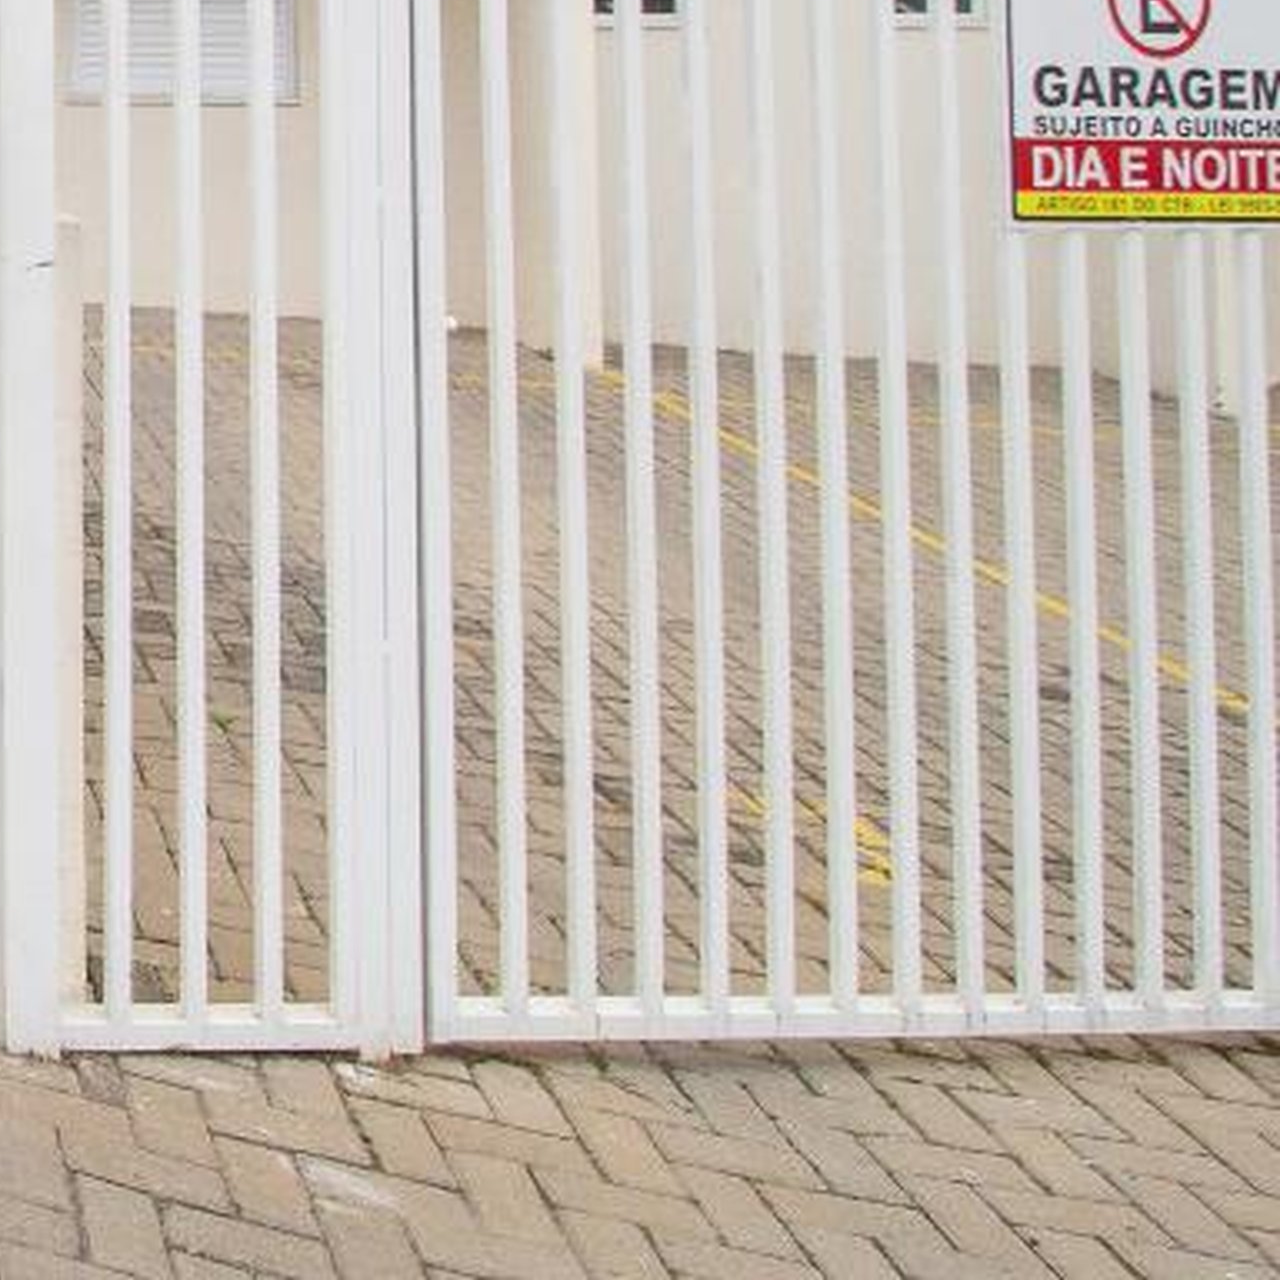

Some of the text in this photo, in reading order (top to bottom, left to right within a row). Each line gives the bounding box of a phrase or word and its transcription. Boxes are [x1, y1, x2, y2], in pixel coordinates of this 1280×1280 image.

[1034, 116, 1142, 137] SUJEITO
[1150, 117, 1168, 137] A
[1031, 145, 1110, 188] DIA
[1120, 146, 1150, 188] E
